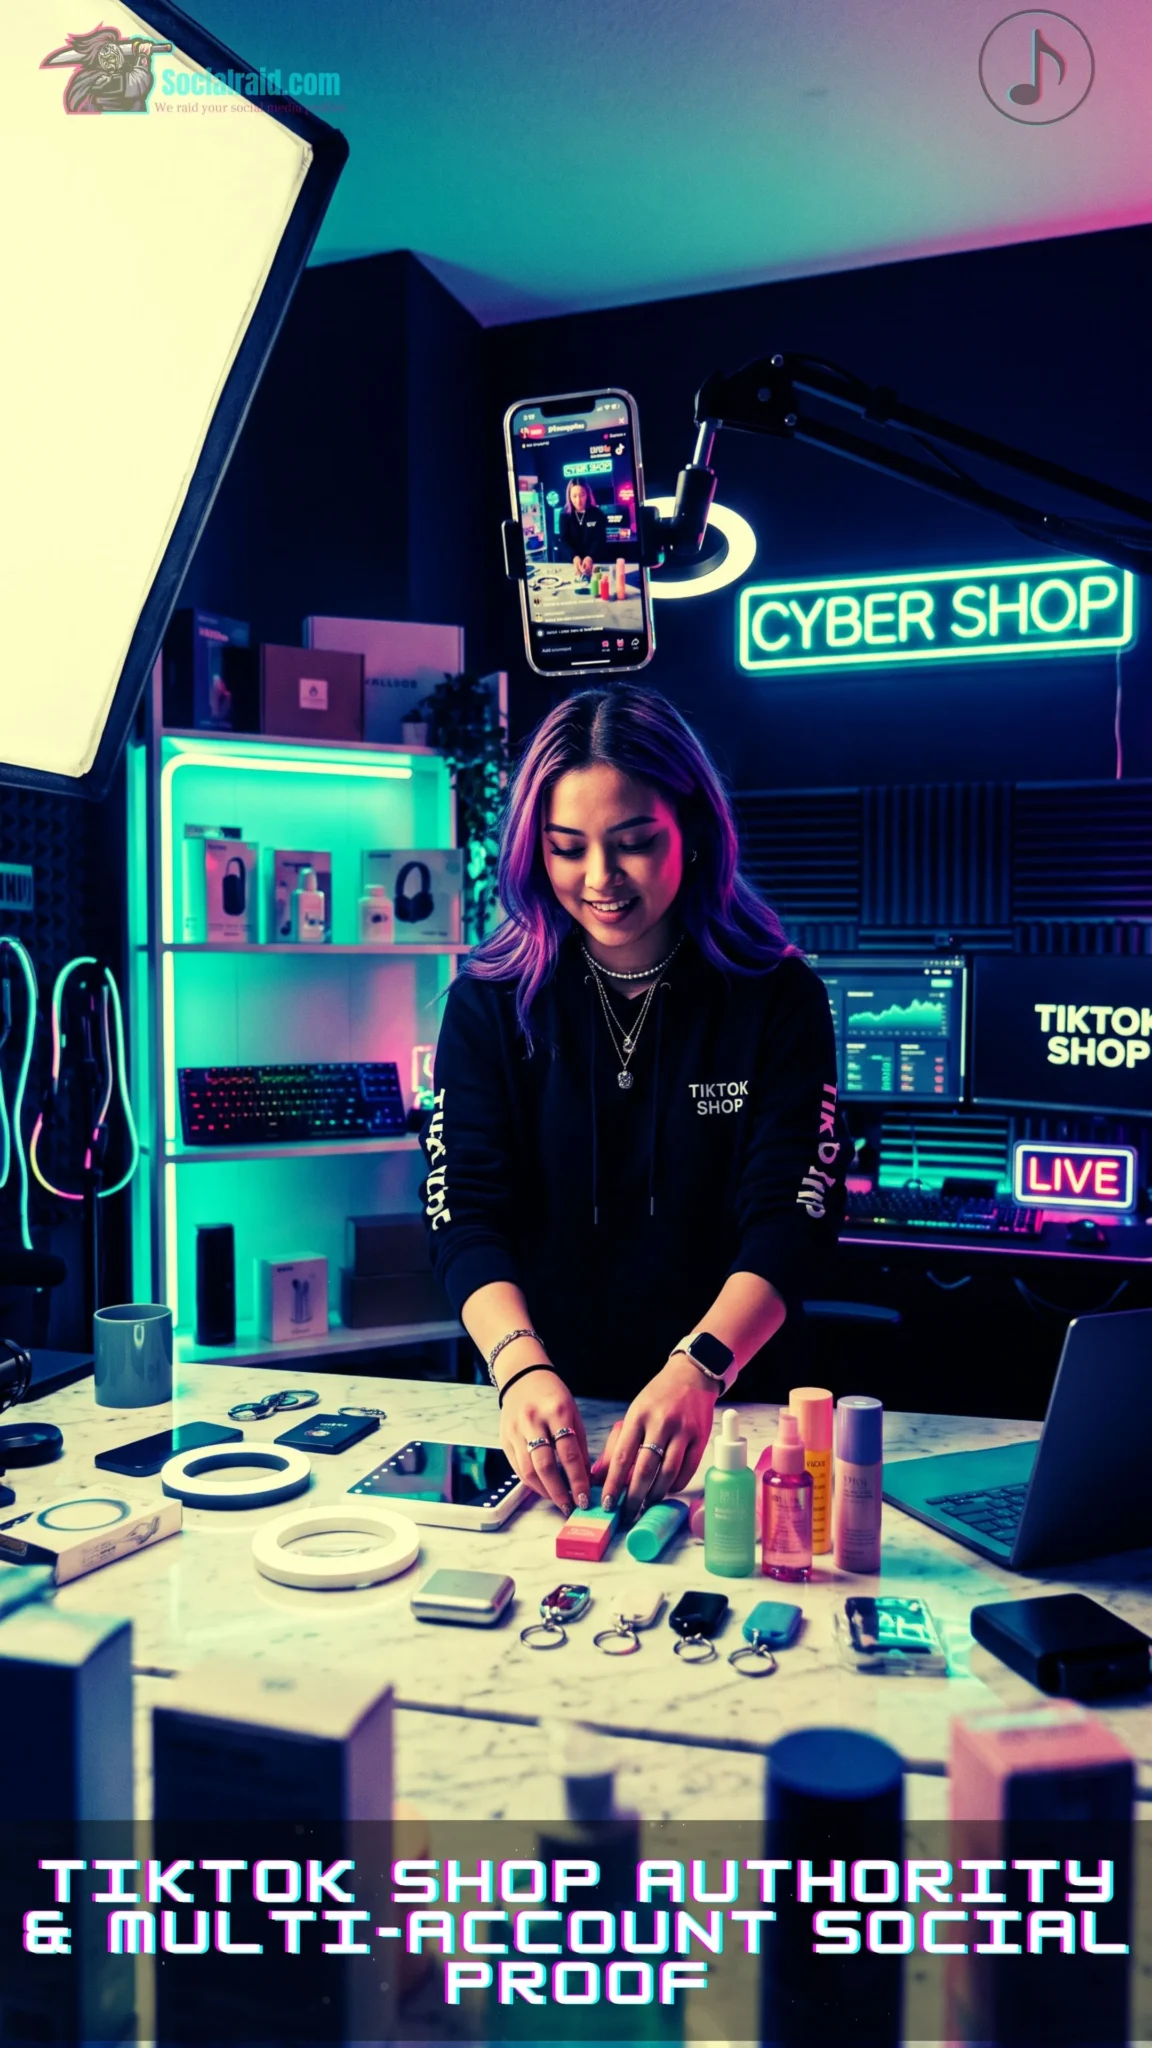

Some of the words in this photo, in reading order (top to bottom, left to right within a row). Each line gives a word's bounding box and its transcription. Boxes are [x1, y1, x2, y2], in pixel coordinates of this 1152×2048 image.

[752, 591, 935, 652] CYBER
[950, 576, 1118, 638] SHOP
[1047, 1036, 1151, 1069] SHOP
[688, 1080, 749, 1098] TIKTOK
[697, 1098, 743, 1115] SHOP
[1027, 1156, 1121, 1196] LIVE
